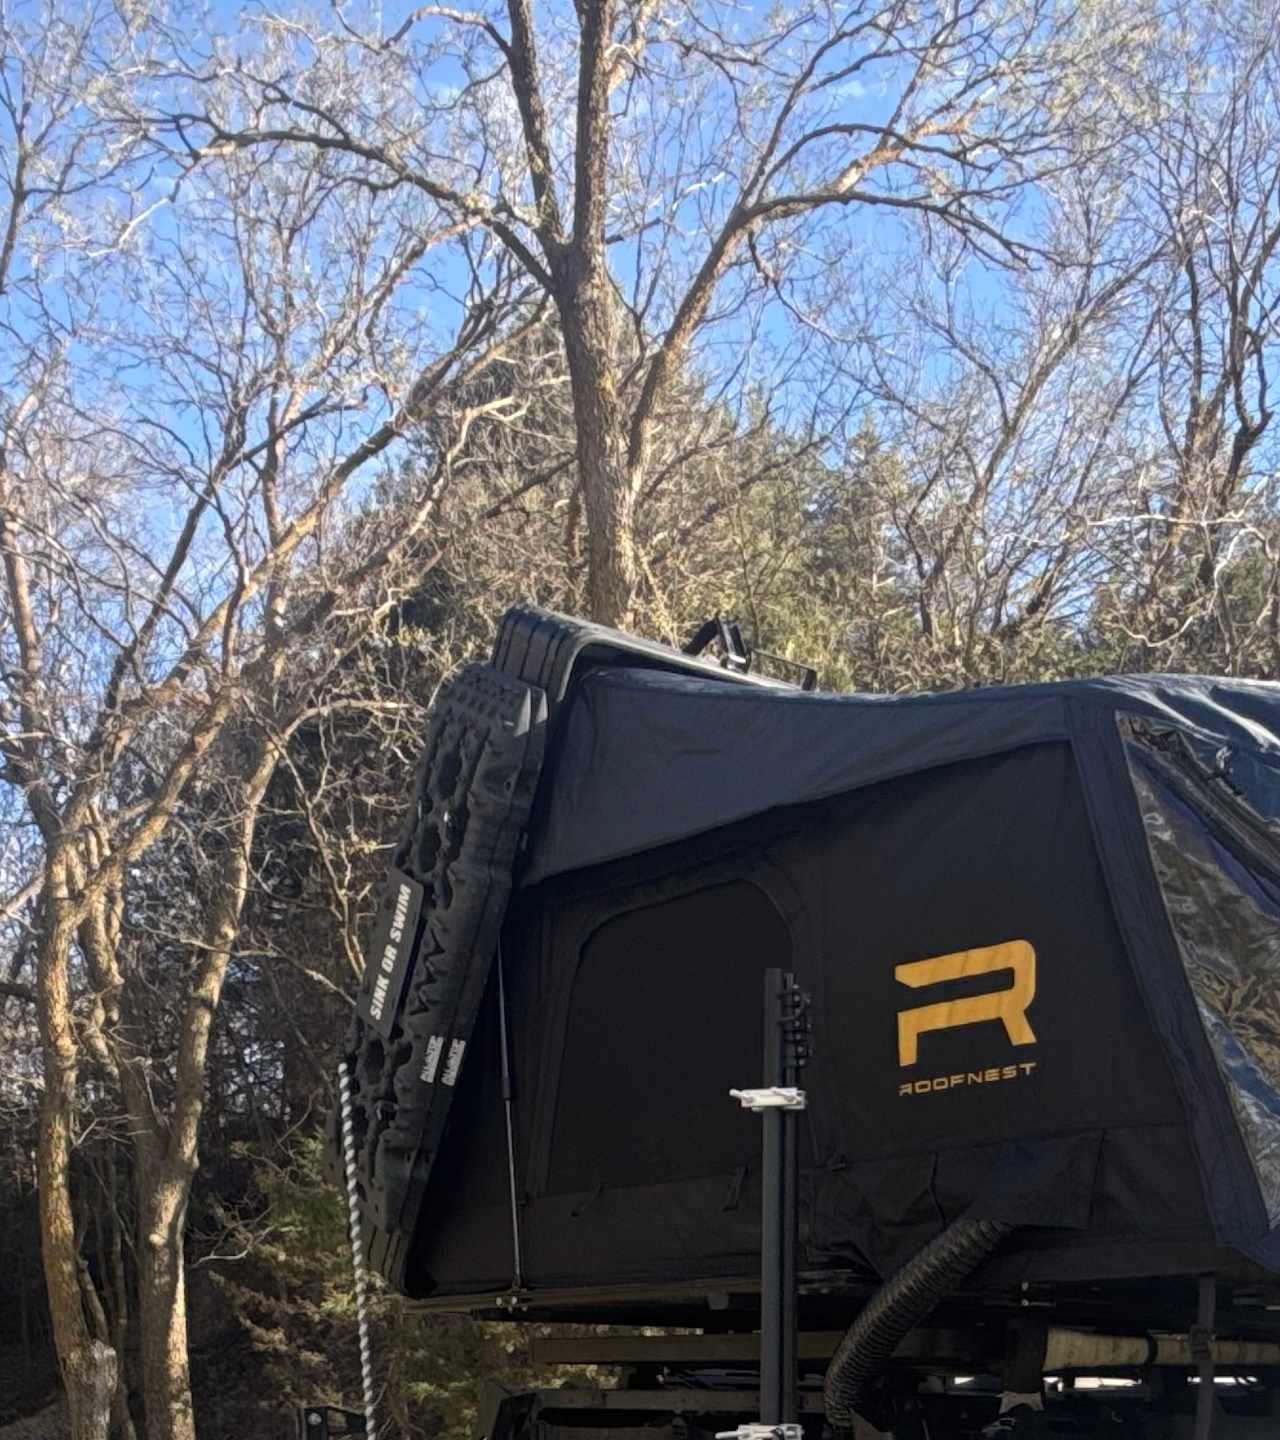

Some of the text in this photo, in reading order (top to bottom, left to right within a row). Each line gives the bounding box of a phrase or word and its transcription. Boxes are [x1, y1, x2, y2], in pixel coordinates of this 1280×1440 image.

[370, 883, 412, 1020] SINK OR SWIM
[898, 1062, 1037, 1097] ROOFNEST
